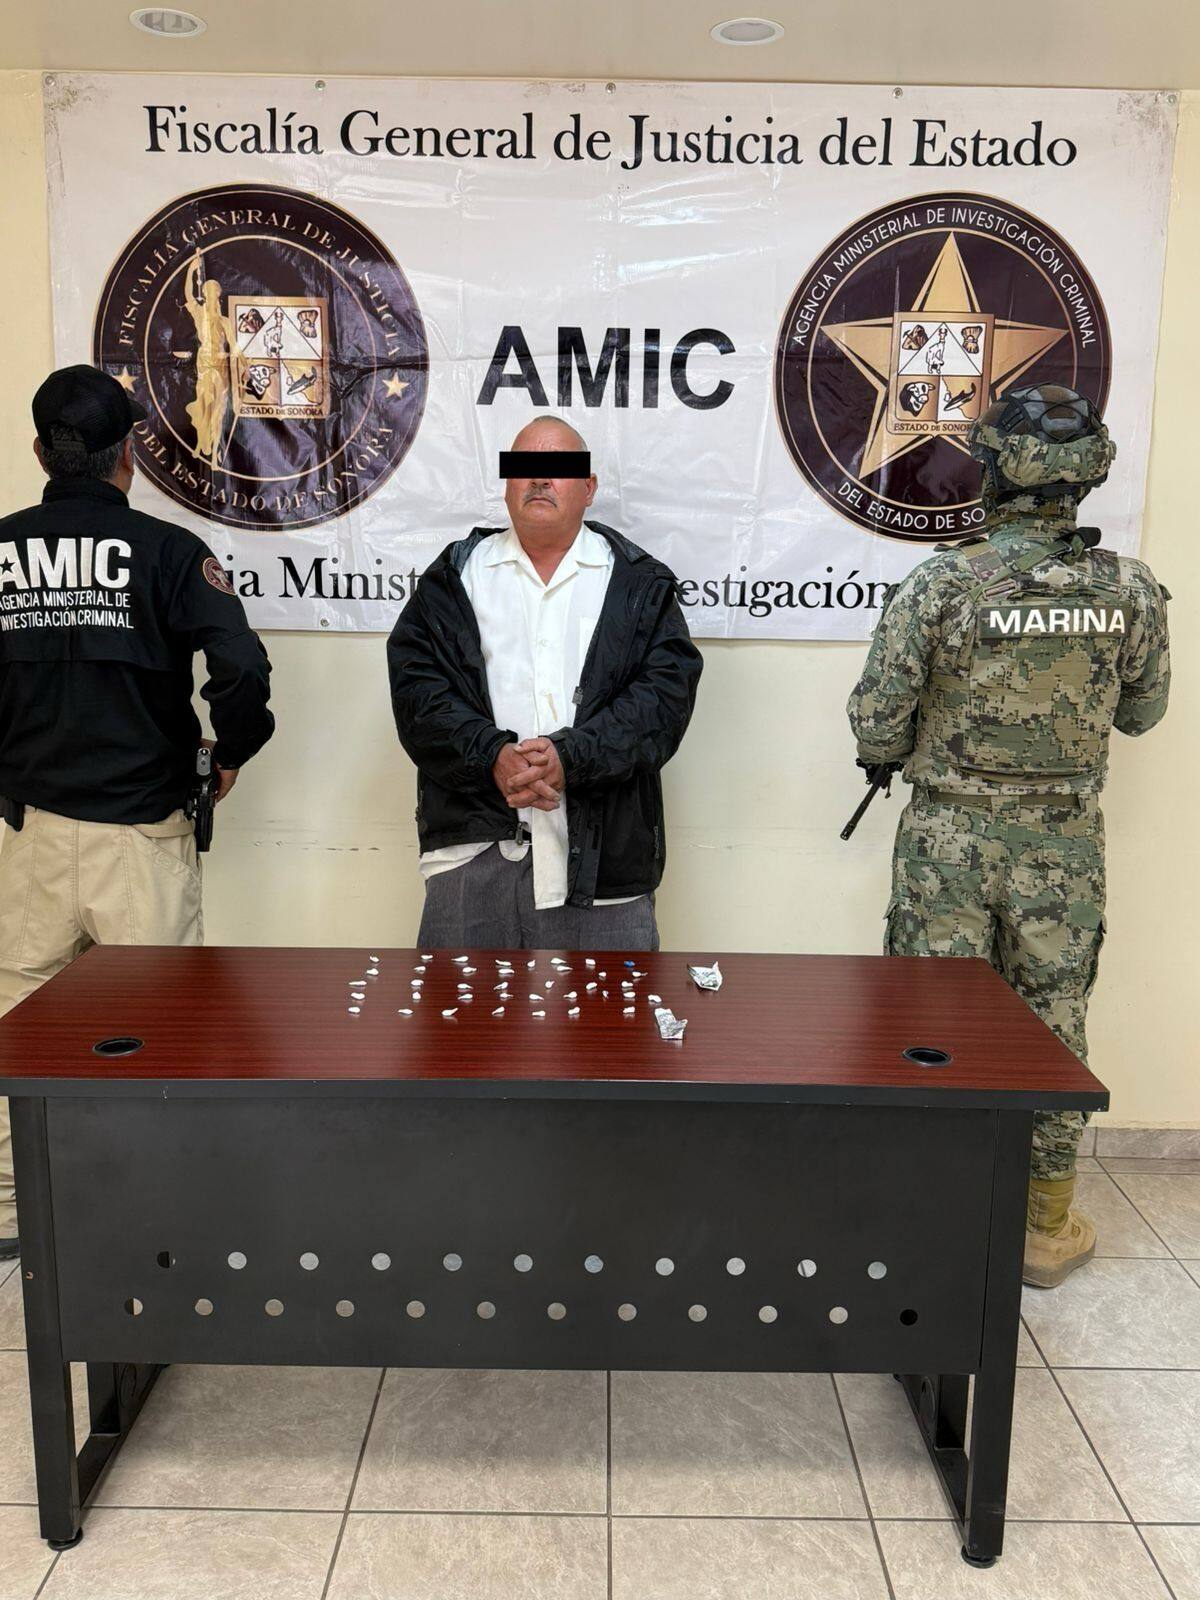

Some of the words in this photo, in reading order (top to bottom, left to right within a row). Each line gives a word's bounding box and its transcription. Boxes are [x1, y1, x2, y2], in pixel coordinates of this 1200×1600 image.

[143, 104, 323, 156] Fiscalía
[340, 109, 536, 160] General
[553, 113, 611, 161] de
[621, 115, 803, 170] Justicia
[819, 117, 893, 166] del
[909, 119, 1078, 168] Estado
[119, 246, 180, 346] FISCALÍA
[182, 209, 296, 246] GENERAL
[302, 222, 338, 250] DE
[792, 273, 836, 346] AGENCIA
[833, 211, 921, 273] MINISTERIAL
[927, 207, 946, 224] DE
[951, 207, 1064, 274] INVESTIGACIÓN
[1059, 272, 1096, 349] CRIMINAL
[476, 325, 736, 411] AMIC
[240, 406, 274, 415] ESTADO
[287, 407, 323, 416] SONORA
[894, 423, 929, 431] ESTADO
[170, 461, 265, 511] ESTADO
[276, 488, 308, 511] DE
[838, 481, 862, 508] DEL
[866, 501, 929, 531] ESTADO
[936, 512, 955, 530] DE
[0, 538, 132, 592] AMIC
[0, 592, 40, 611] AGENCIA
[43, 590, 113, 607] MINISTERIAL
[116, 592, 131, 608] DE
[0, 607, 76, 631] INVESTIGACIÓN
[78, 609, 134, 629] CRIMINAL
[989, 608, 1125, 634] MARINA
